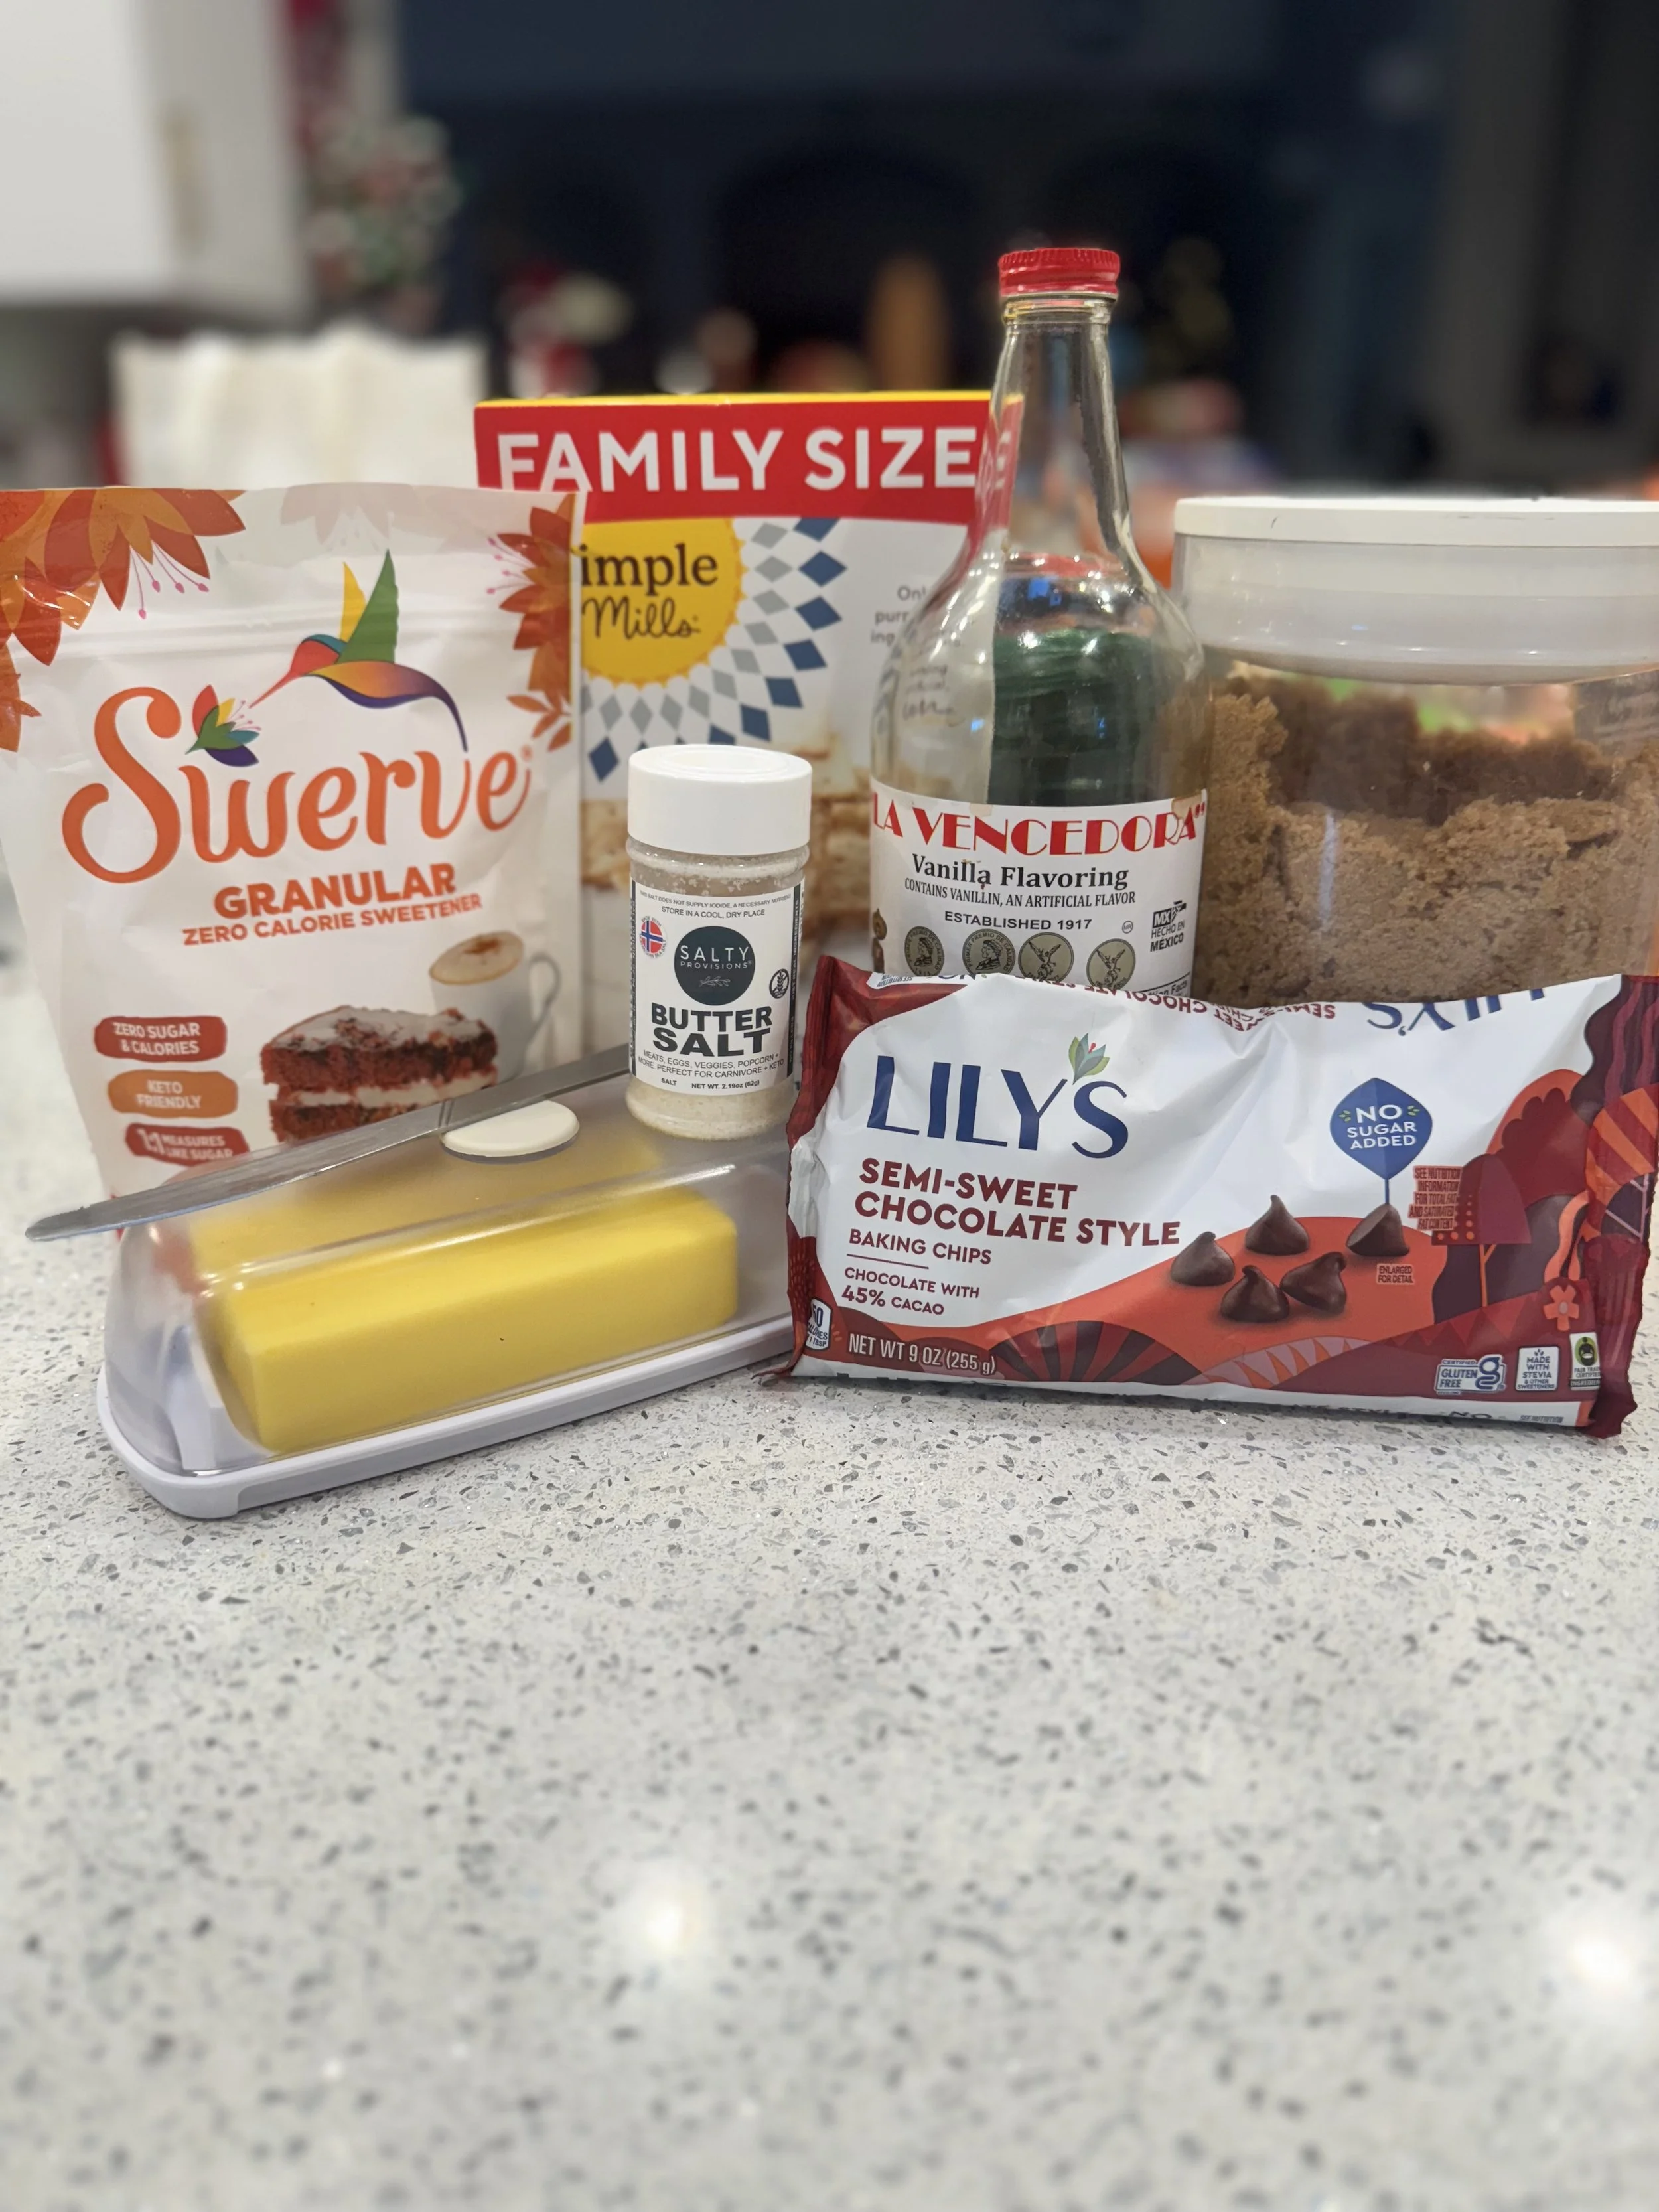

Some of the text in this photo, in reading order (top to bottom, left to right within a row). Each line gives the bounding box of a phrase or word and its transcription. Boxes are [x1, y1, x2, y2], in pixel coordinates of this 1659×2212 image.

[496, 426, 977, 492] FAMILY SIZE
[579, 542, 719, 597] imple
[873, 792, 904, 838] LA
[912, 853, 1129, 891] Vanilla Flavoring
[214, 863, 456, 919] GRANULAR
[771, 894, 791, 903] NUTRIENT
[905, 877, 1135, 907] CONTAINS VANILLIN, AN ARTIFICIAL FLAVOR
[182, 893, 482, 946] ZERO CALORIE SWEETENER
[662, 906, 684, 916] STORE
[945, 911, 1092, 930] ESTABLISHED 1917
[1151, 920, 1185, 939] HECHO EN
[680, 944, 749, 962] SALTY
[971, 932, 995, 944] PREMIO
[995, 934, 1003, 944] DE
[1002, 941, 1012, 972] CALIDAD
[680, 961, 748, 970] PROVISIONS
[651, 1003, 773, 1032] BUTTER
[113, 1021, 201, 1039] ZERO SUGAR
[121, 1039, 200, 1055] & CALORIES
[652, 1027, 771, 1057] SALT
[738, 1054, 774, 1067] POPCORN
[657, 1064, 692, 1076] PERFECT
[715, 1067, 762, 1078] CARNIVORE
[147, 1079, 183, 1094] KETO
[135, 1094, 202, 1109] FRIENDLY
[1356, 1104, 1403, 1124] NO
[1347, 1121, 1417, 1138] SUGAR
[161, 1134, 226, 1147] MEASURES
[1350, 1135, 1416, 1150] ADDED
[190, 1149, 234, 1160] SUGAR
[1414, 1167, 1461, 1179] SEE NUTRITION
[859, 1157, 1078, 1210] SEMI-SWEET
[1418, 1181, 1459, 1192] INFORMATION
[1415, 1193, 1427, 1205] FOR
[854, 1191, 1181, 1246] CHOCOLATE STYLE
[1409, 1205, 1454, 1217] AND SATURATED
[1418, 1218, 1453, 1230] FAT CONTENT
[849, 1228, 992, 1265] BAKING CHIPS
[1379, 1266, 1412, 1274] ENLARGED
[1392, 1274, 1413, 1283] DETAIL
[844, 1266, 980, 1299] CHOCOLATE WITH
[841, 1285, 945, 1316] 45% CACAO
[813, 1337, 827, 1347] TBSP
[849, 1333, 995, 1375] NET WT 9 OZ (255 g)
[1441, 1368, 1478, 1379] GLUTEN
[1439, 1379, 1461, 1388] FREE
